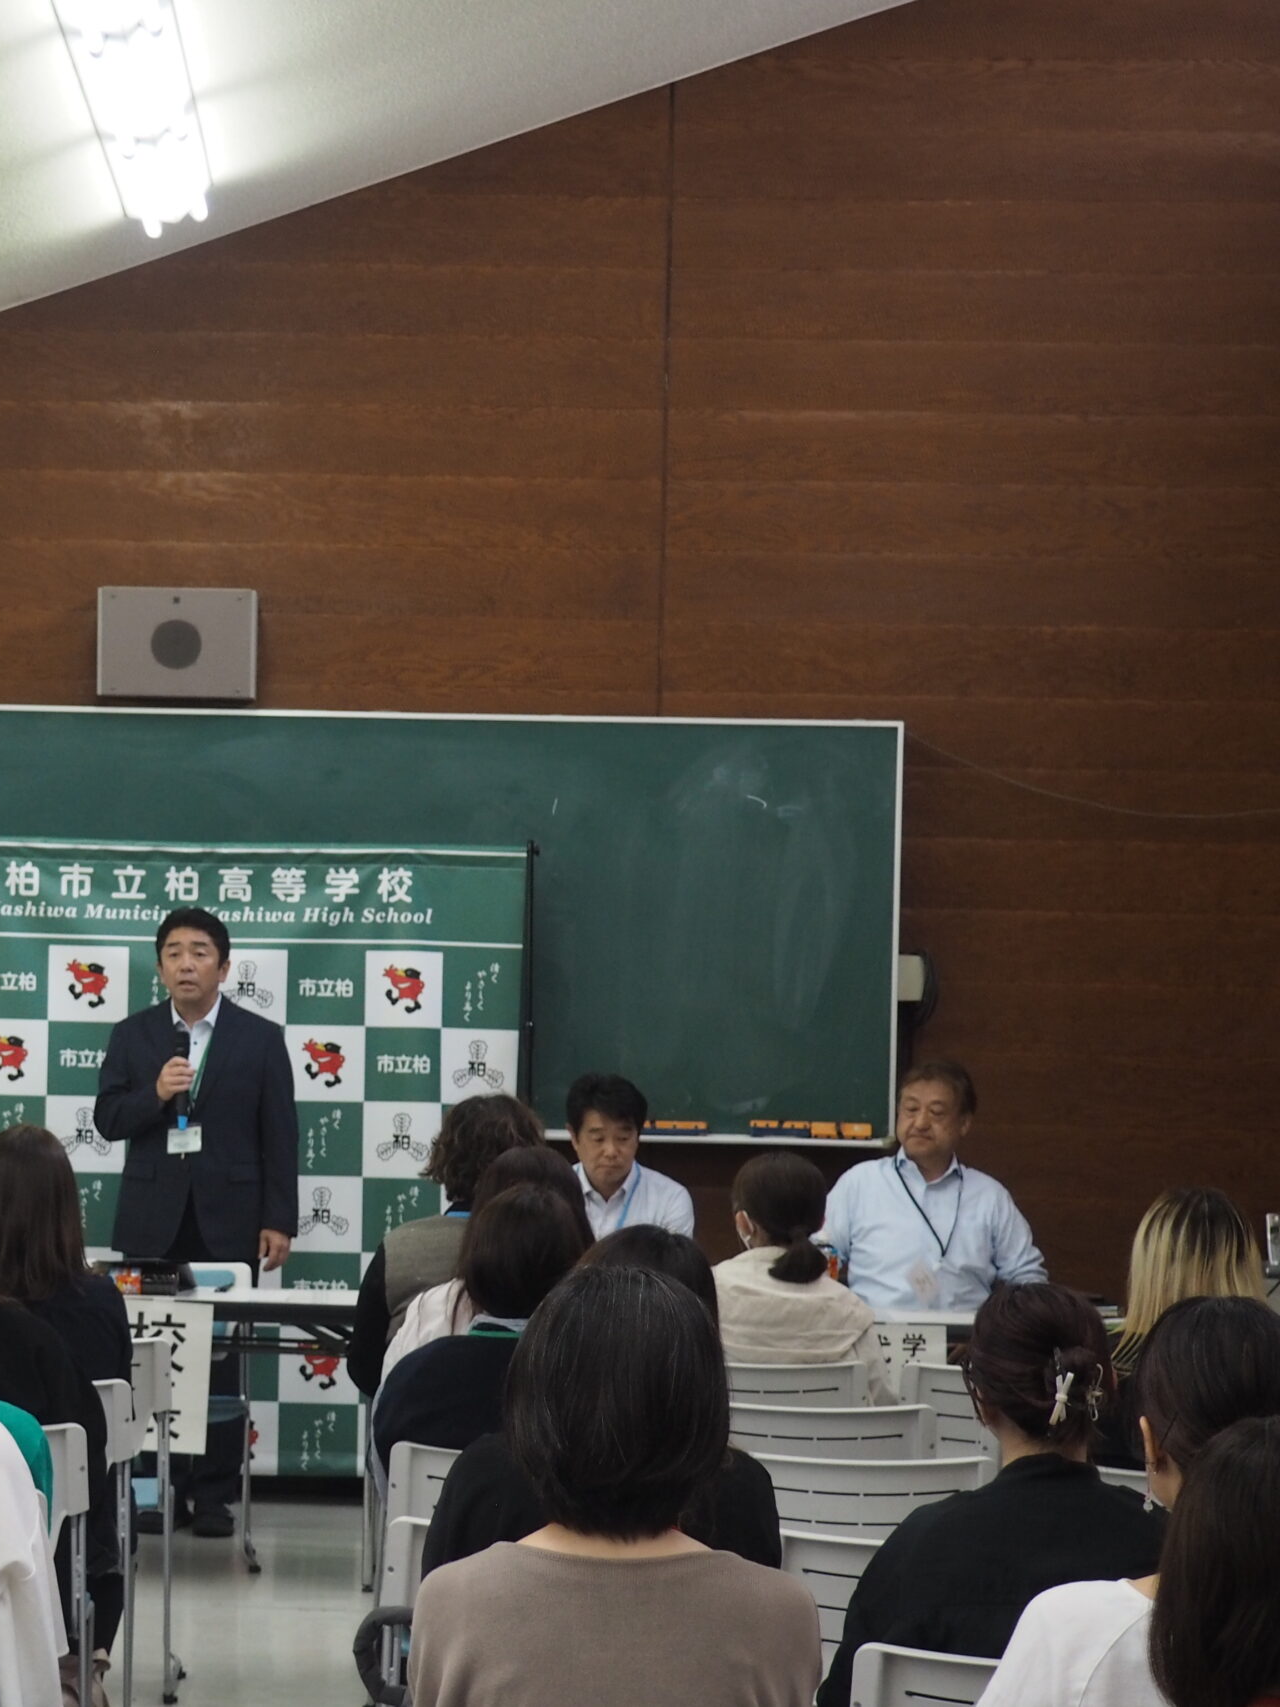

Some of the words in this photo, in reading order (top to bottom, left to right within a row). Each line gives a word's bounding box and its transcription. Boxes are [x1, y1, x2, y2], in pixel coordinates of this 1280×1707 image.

[5, 860, 413, 903] 柏市立柏高等学校
[85, 903, 194, 925] Municip
[303, 908, 354, 926] High
[361, 907, 433, 925] School
[298, 977, 354, 998] 市立柏
[376, 1054, 431, 1074] 市立柏
